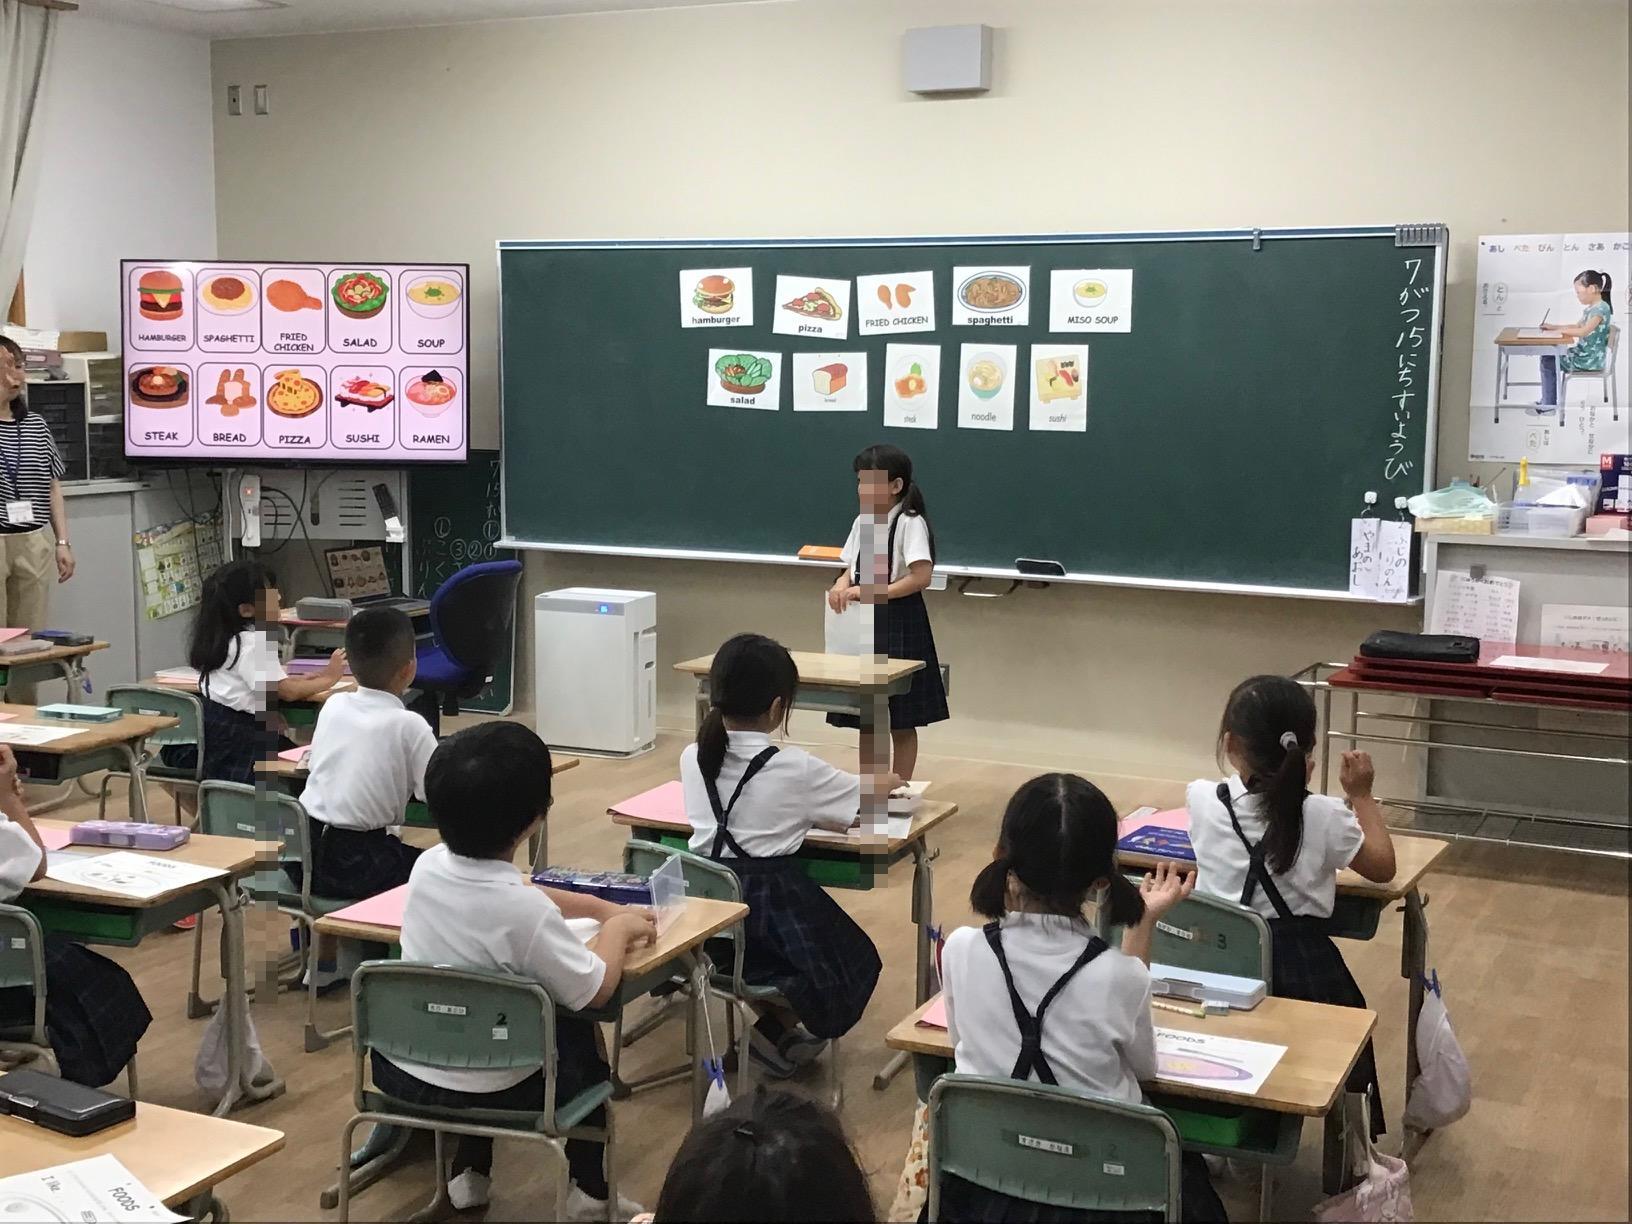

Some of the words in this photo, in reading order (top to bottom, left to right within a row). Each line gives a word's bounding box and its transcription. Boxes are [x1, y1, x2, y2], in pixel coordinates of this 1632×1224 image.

[692, 314, 741, 327] hamburger
[865, 317, 891, 328] FRIED
[892, 315, 929, 327] CHICKEN
[967, 315, 1014, 327] spaghetti
[1067, 315, 1093, 325] MISO
[1095, 314, 1119, 325] SOUP
[798, 323, 824, 335] pizza
[138, 334, 187, 342] HAMBURGER
[203, 334, 255, 344] SPAGHETTI
[279, 332, 308, 342] FRIED
[342, 337, 378, 348] SALAD
[273, 342, 315, 352] CHICKEN
[417, 338, 446, 349] SOUP
[730, 395, 756, 406] salad
[971, 411, 997, 422] noodle
[144, 431, 179, 442] STEAK
[212, 432, 247, 443] BREAD
[279, 434, 311, 445] PIZZA
[345, 433, 380, 444] SUSHI
[412, 434, 450, 445] RAMEN
[1602, 455, 1612, 465] M
[496, 1012, 507, 1026] 2
[1156, 1032, 1206, 1044] FOODS
[108, 1187, 140, 1212] FOODS
